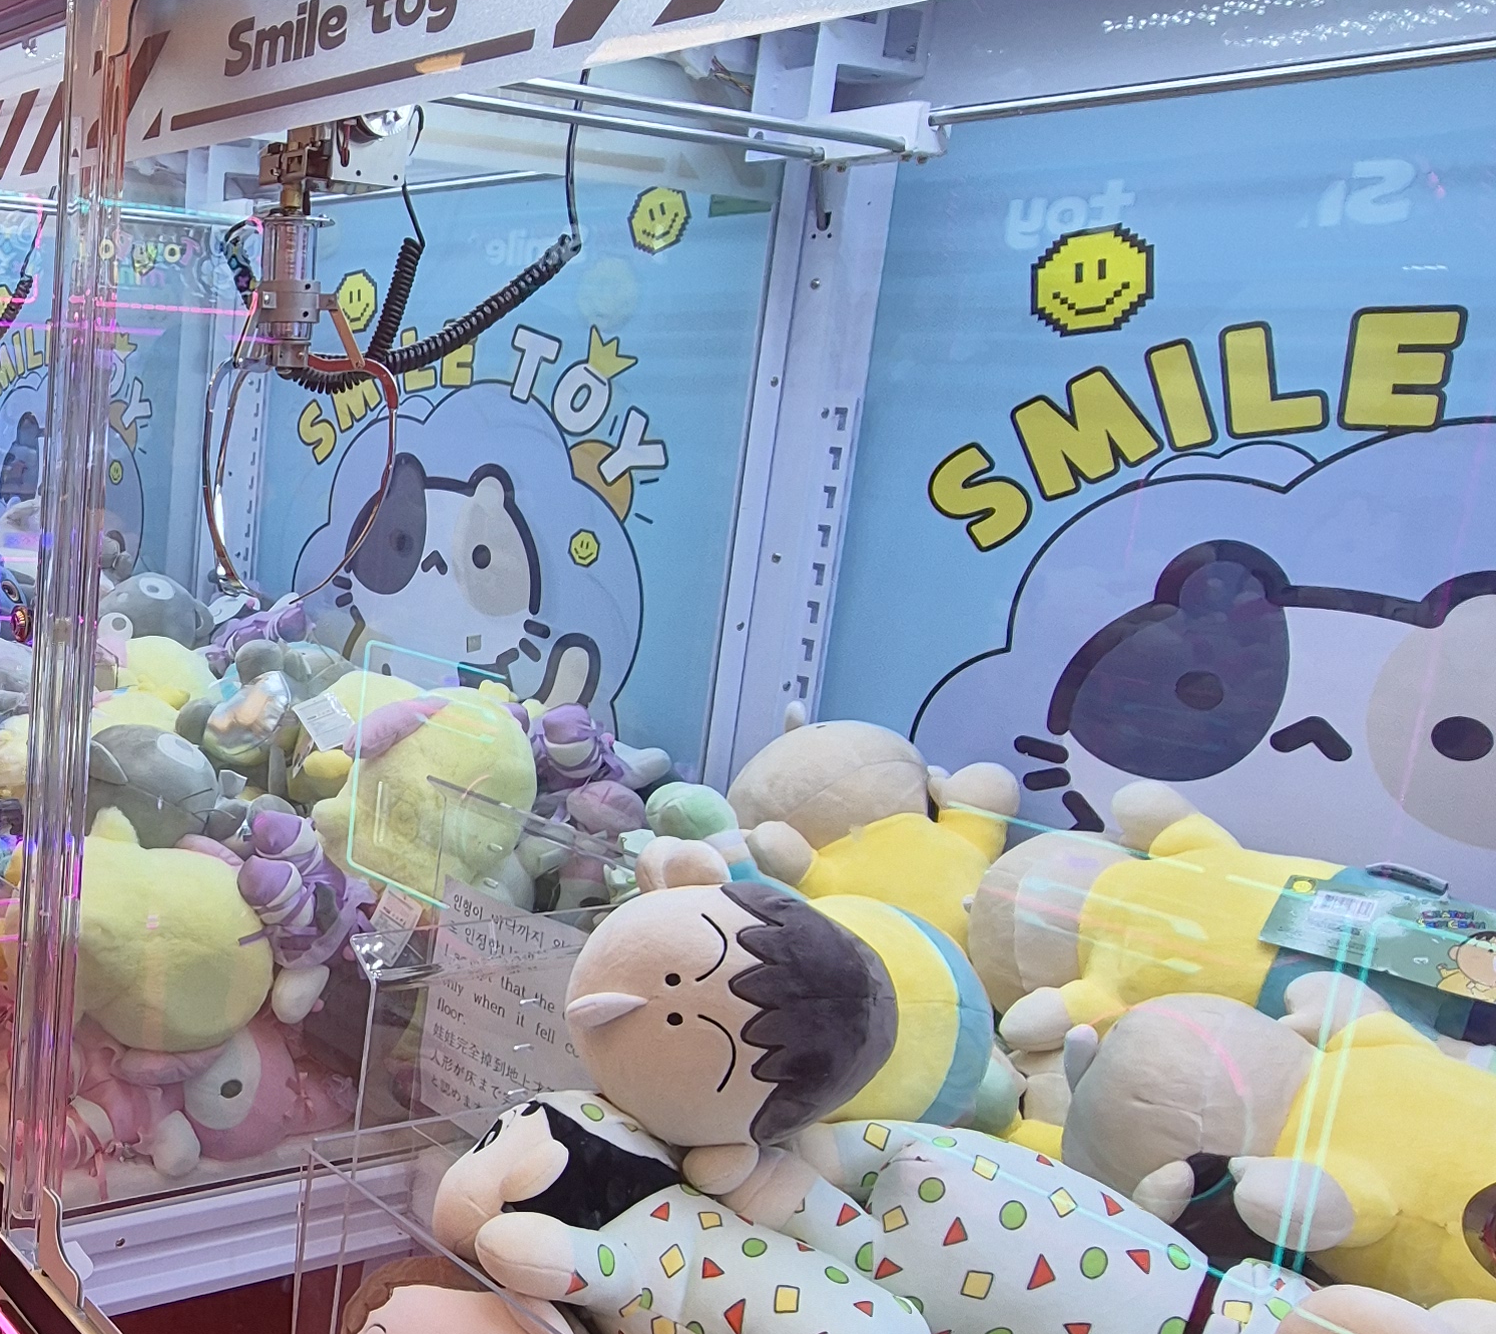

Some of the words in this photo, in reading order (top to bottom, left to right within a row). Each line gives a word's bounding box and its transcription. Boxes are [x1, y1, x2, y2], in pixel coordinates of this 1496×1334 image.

[297, 318, 477, 466] SMLE
[511, 324, 669, 486] TOY
[926, 305, 1469, 553] SMILE
[453, 893, 484, 920] 인형이
[500, 974, 527, 999] that
[436, 997, 467, 1026] floor.
[473, 992, 506, 1017] when
[515, 1011, 525, 1028] it
[535, 1022, 556, 1045] fell
